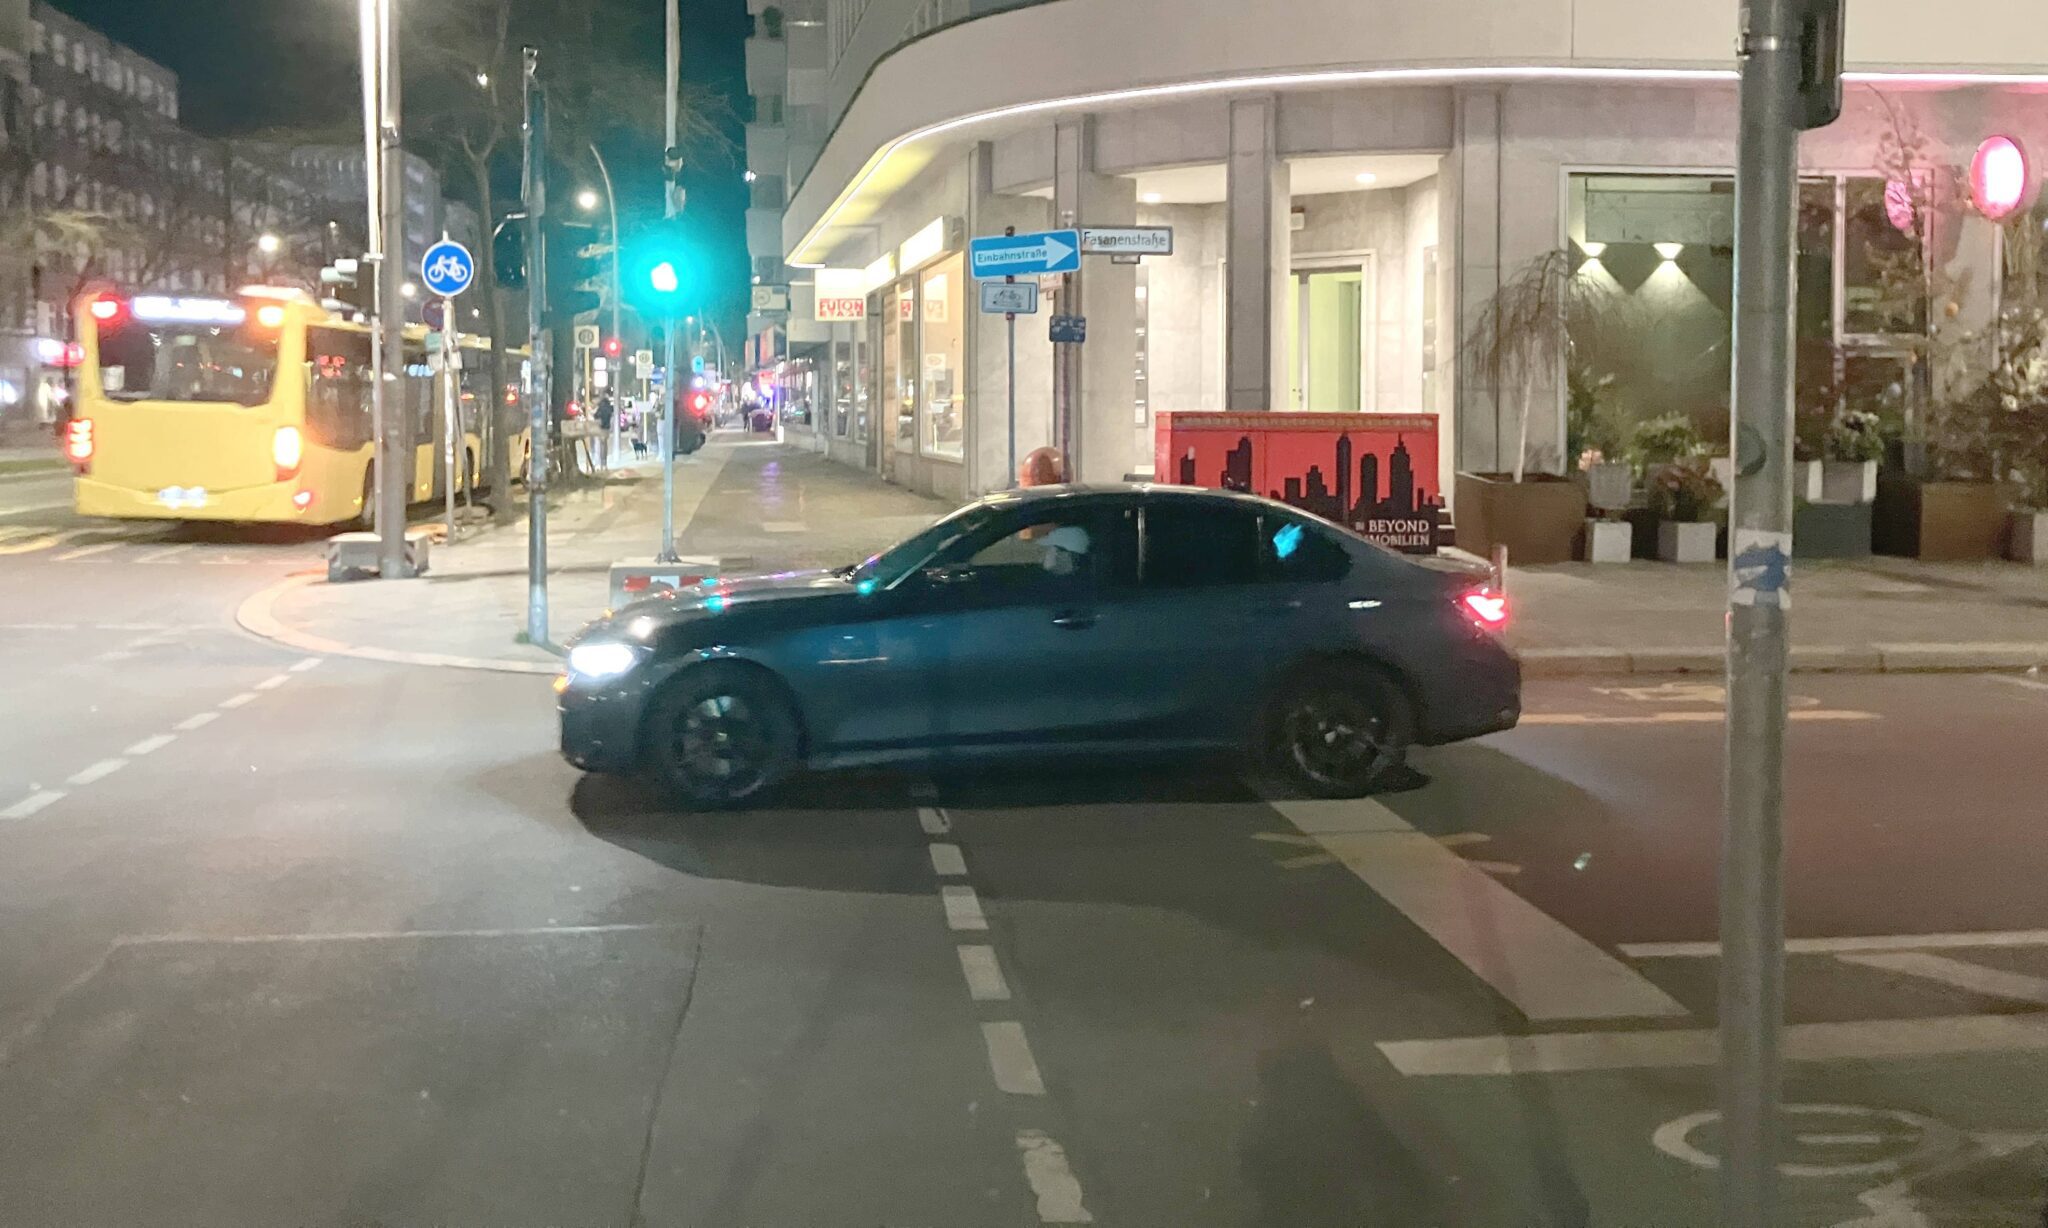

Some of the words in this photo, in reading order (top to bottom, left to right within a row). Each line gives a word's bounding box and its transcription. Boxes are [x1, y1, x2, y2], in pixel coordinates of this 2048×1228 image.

[1084, 231, 1166, 248] Fasanenstraße
[978, 249, 1047, 263] Einbahnstraße
[1369, 519, 1429, 532] BEYOND
